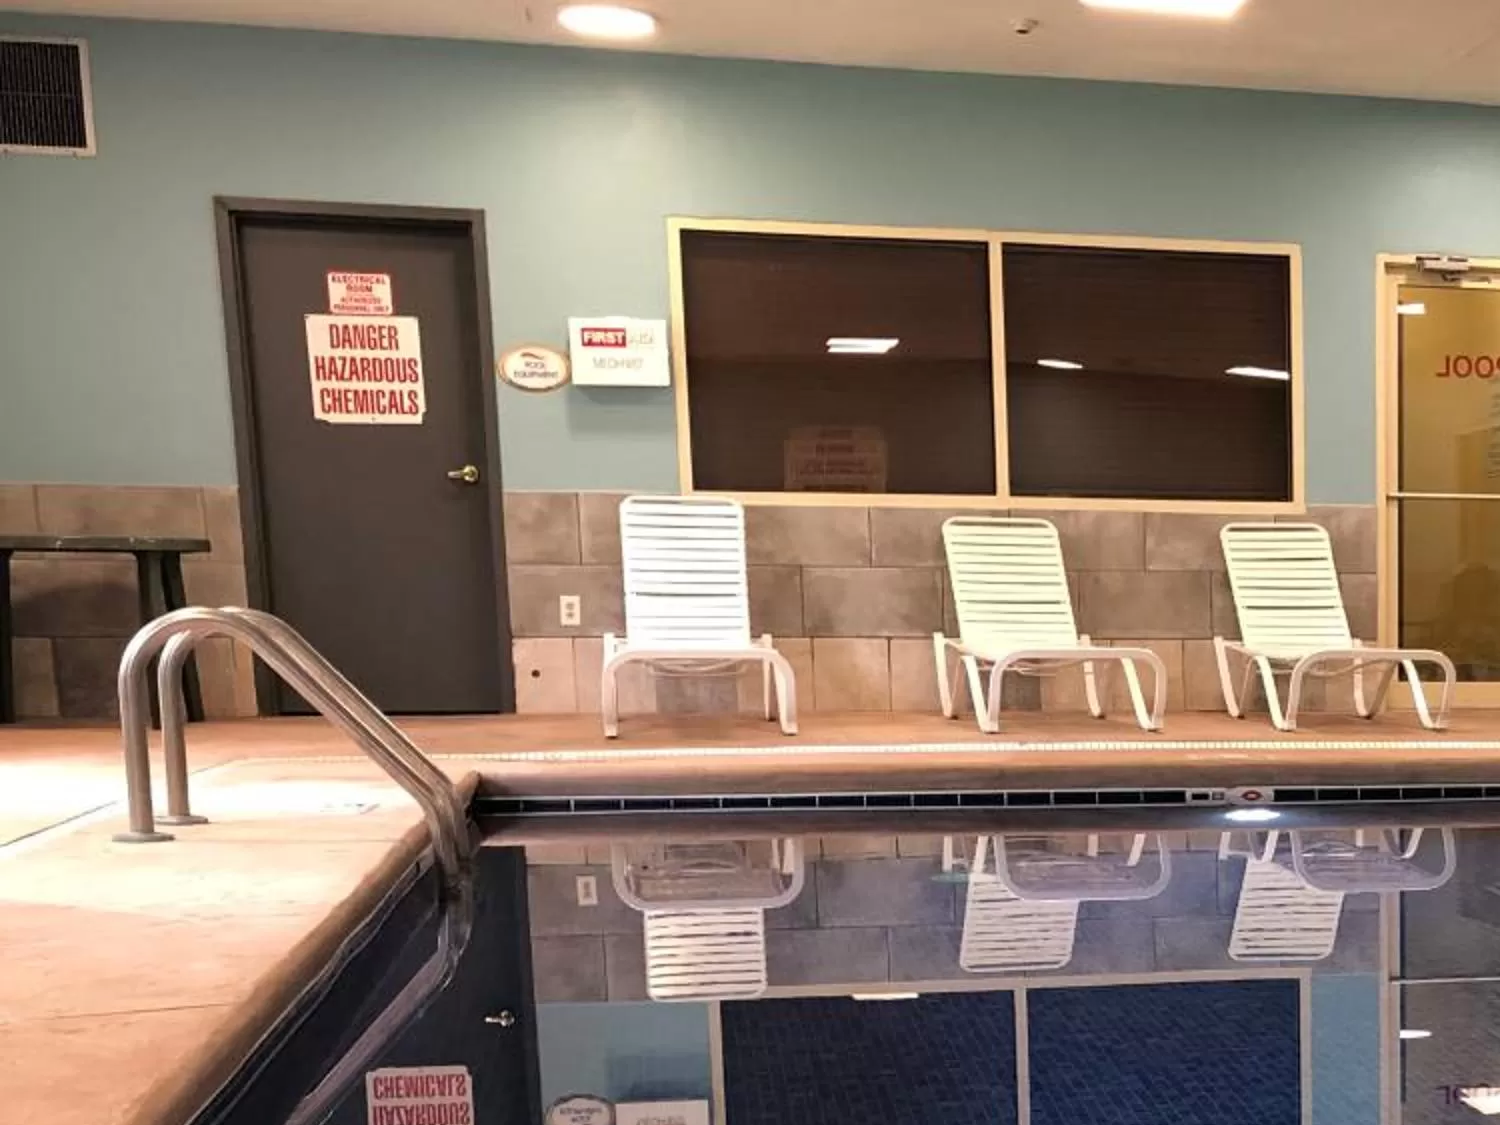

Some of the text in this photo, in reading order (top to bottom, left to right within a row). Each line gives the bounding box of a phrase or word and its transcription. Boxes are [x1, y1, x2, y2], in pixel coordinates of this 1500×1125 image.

[329, 323, 399, 350] DANGER
[583, 330, 625, 345] FIRST
[315, 356, 419, 383] HAZARDOUS
[320, 387, 419, 415] CHEMICALS
